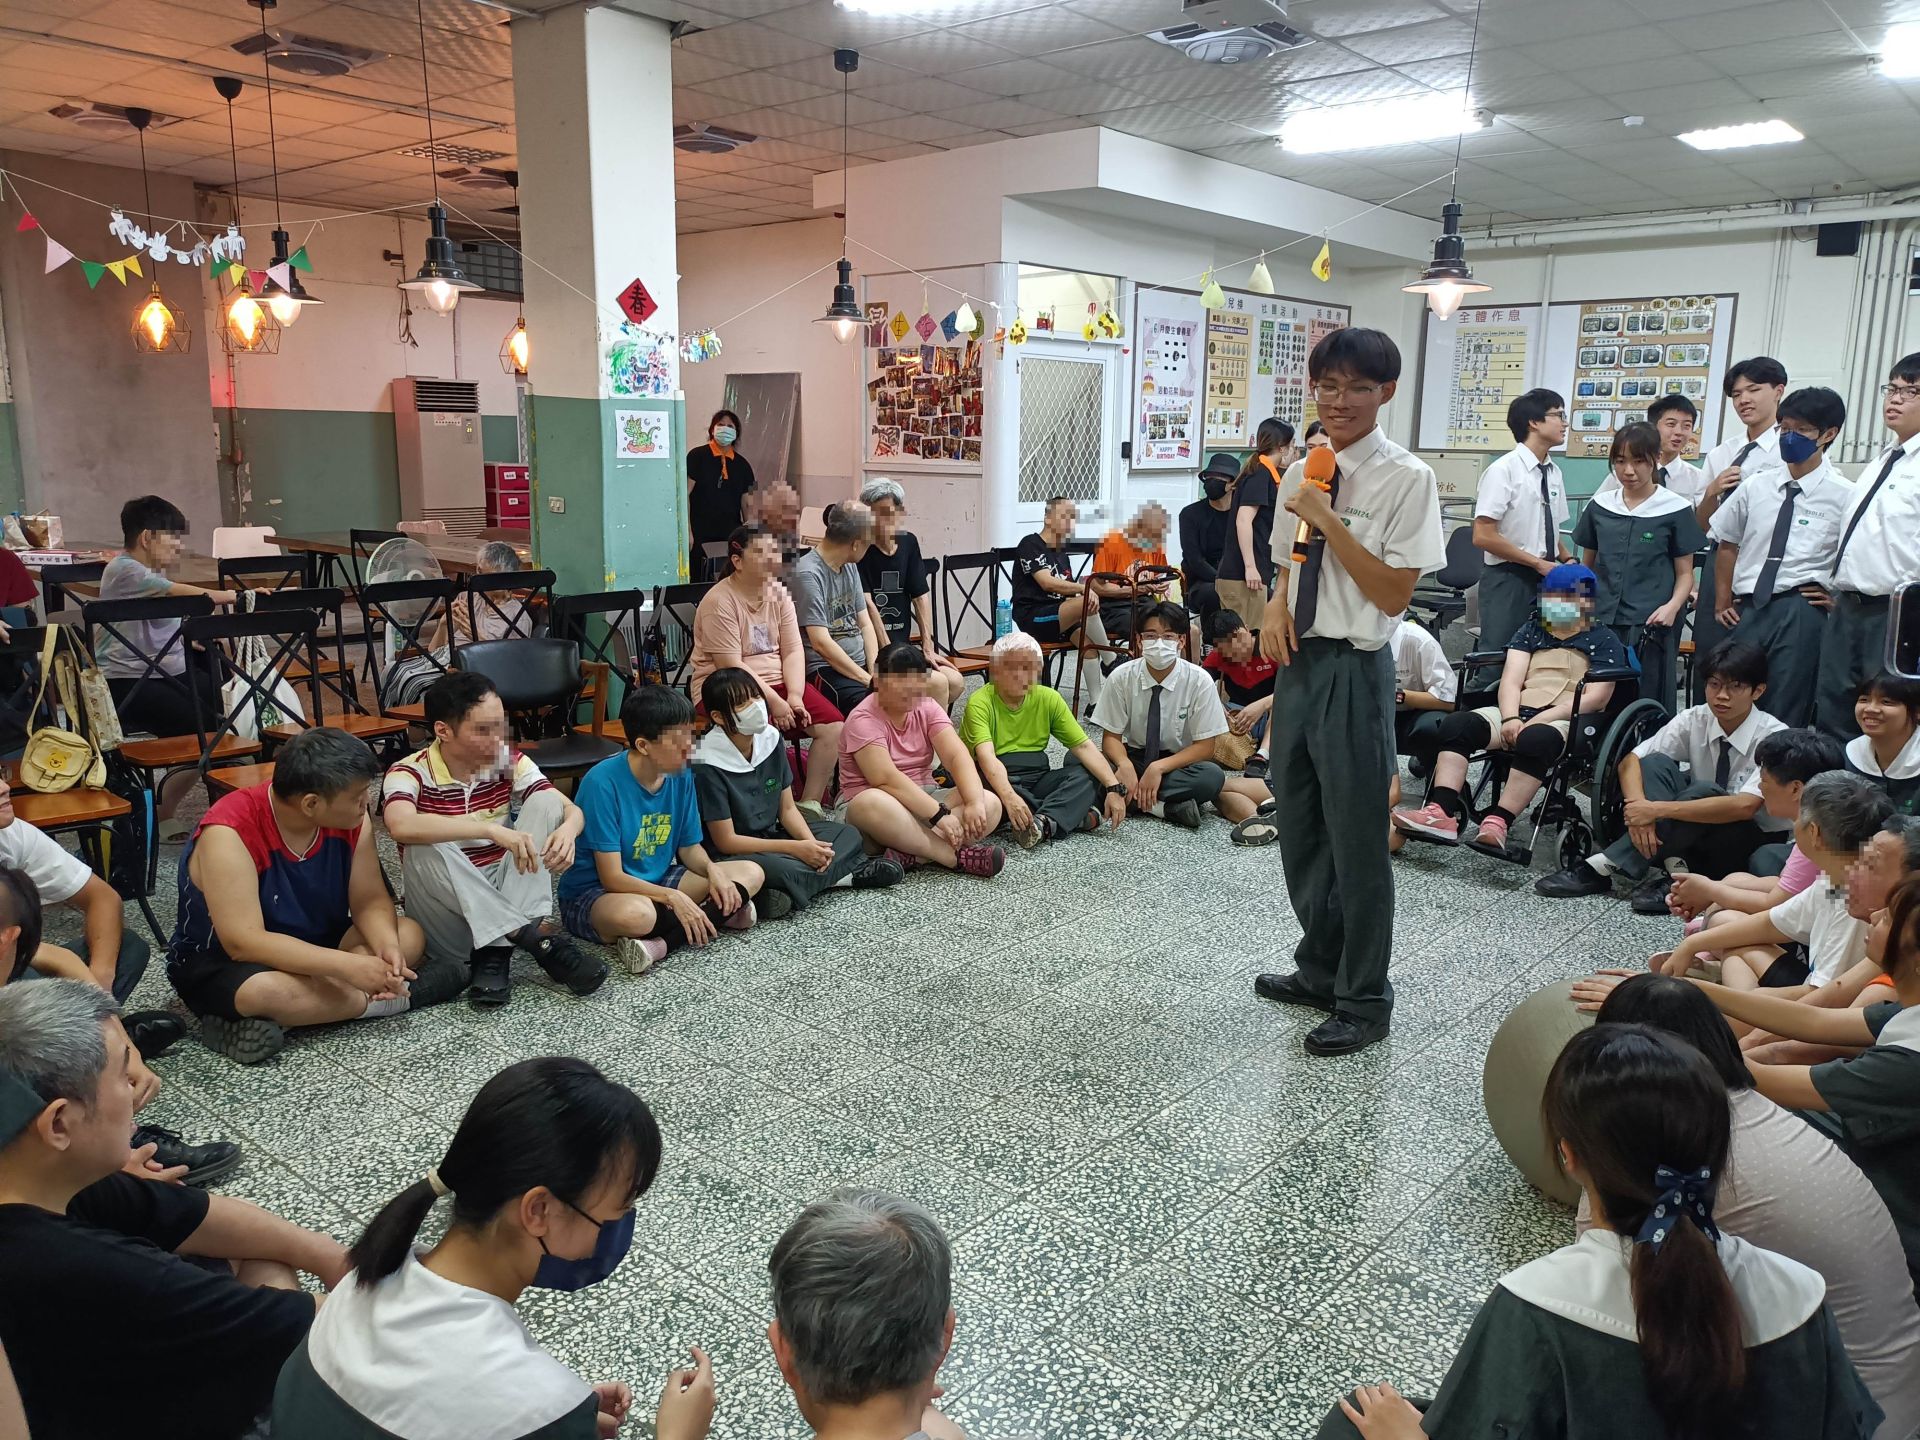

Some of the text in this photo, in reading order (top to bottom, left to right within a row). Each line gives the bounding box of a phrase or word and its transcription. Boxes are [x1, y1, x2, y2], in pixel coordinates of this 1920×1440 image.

[628, 284, 647, 316] 春
[1459, 309, 1520, 323] 全體作息
